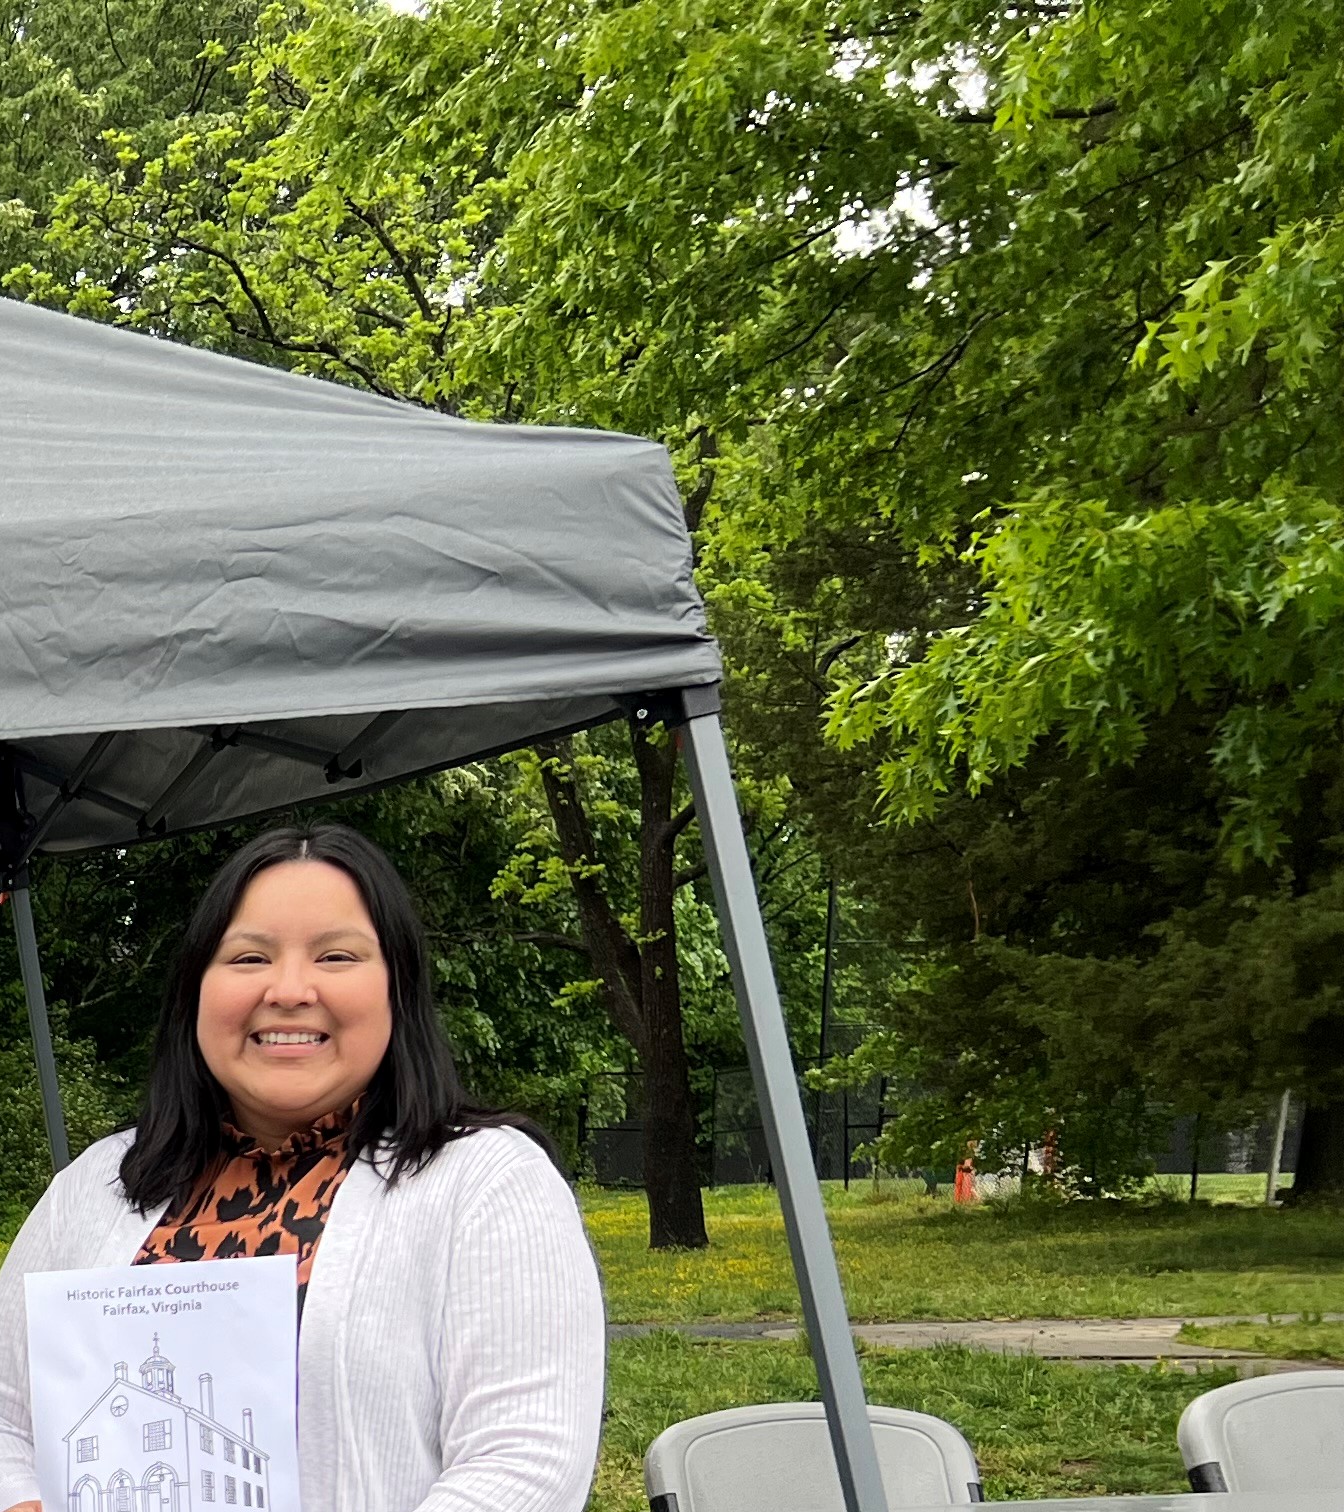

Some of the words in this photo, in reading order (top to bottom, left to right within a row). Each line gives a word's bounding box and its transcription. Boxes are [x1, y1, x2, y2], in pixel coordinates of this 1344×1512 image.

[66, 1287, 115, 1301] Historic
[118, 1284, 162, 1299] Fairfax
[164, 1280, 240, 1296] Courthouse
[102, 1303, 150, 1316] Fairfax,
[151, 1299, 202, 1315] Virginia
